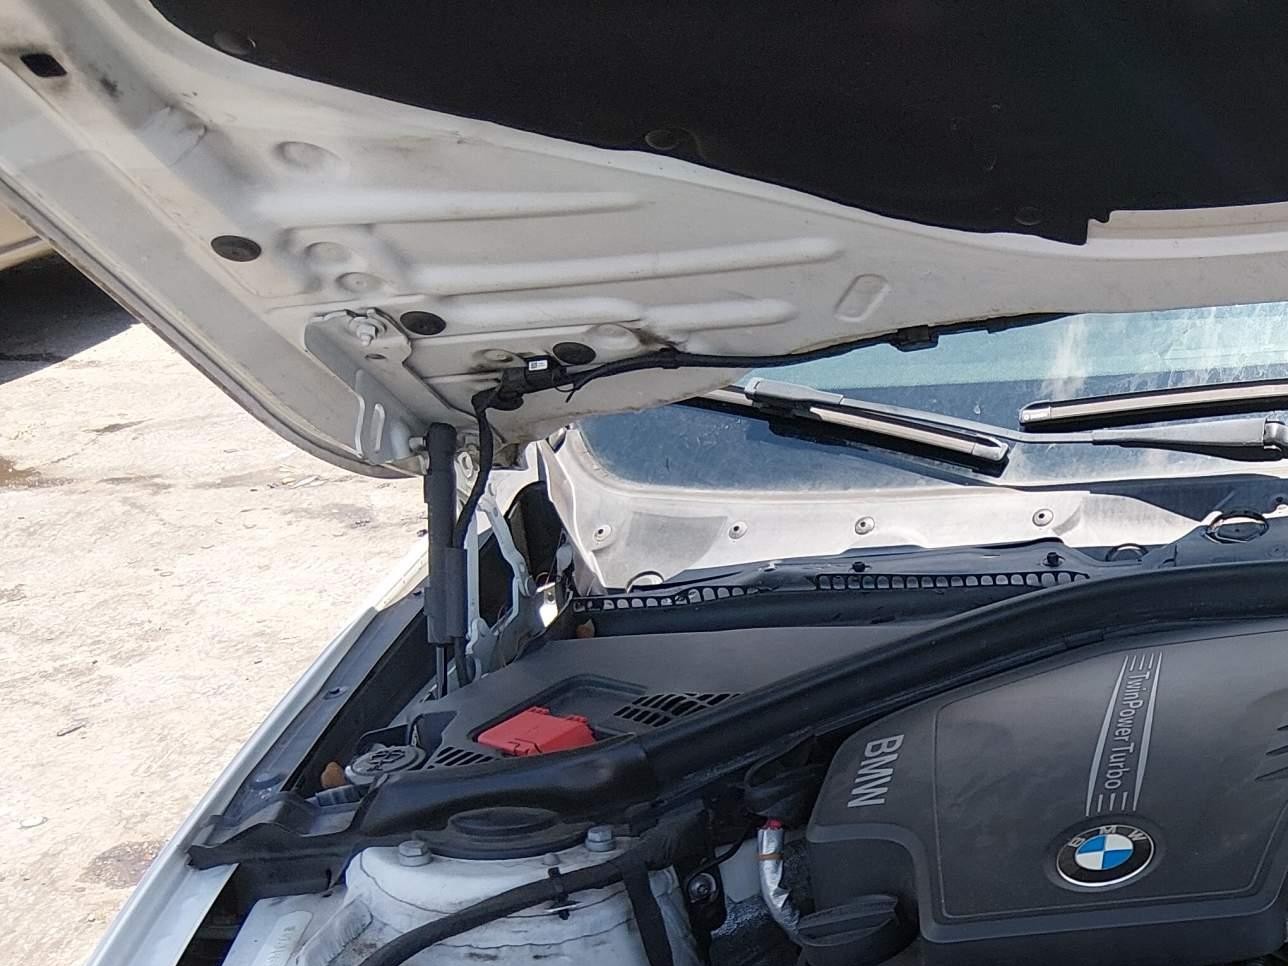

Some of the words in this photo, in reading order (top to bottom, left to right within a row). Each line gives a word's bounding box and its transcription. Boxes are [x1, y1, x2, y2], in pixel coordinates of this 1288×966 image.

[1114, 671, 1150, 741] TwinPower
[847, 734, 905, 808] BMW
[1104, 742, 1135, 790] Turbo
[1067, 825, 1148, 848] BMW
